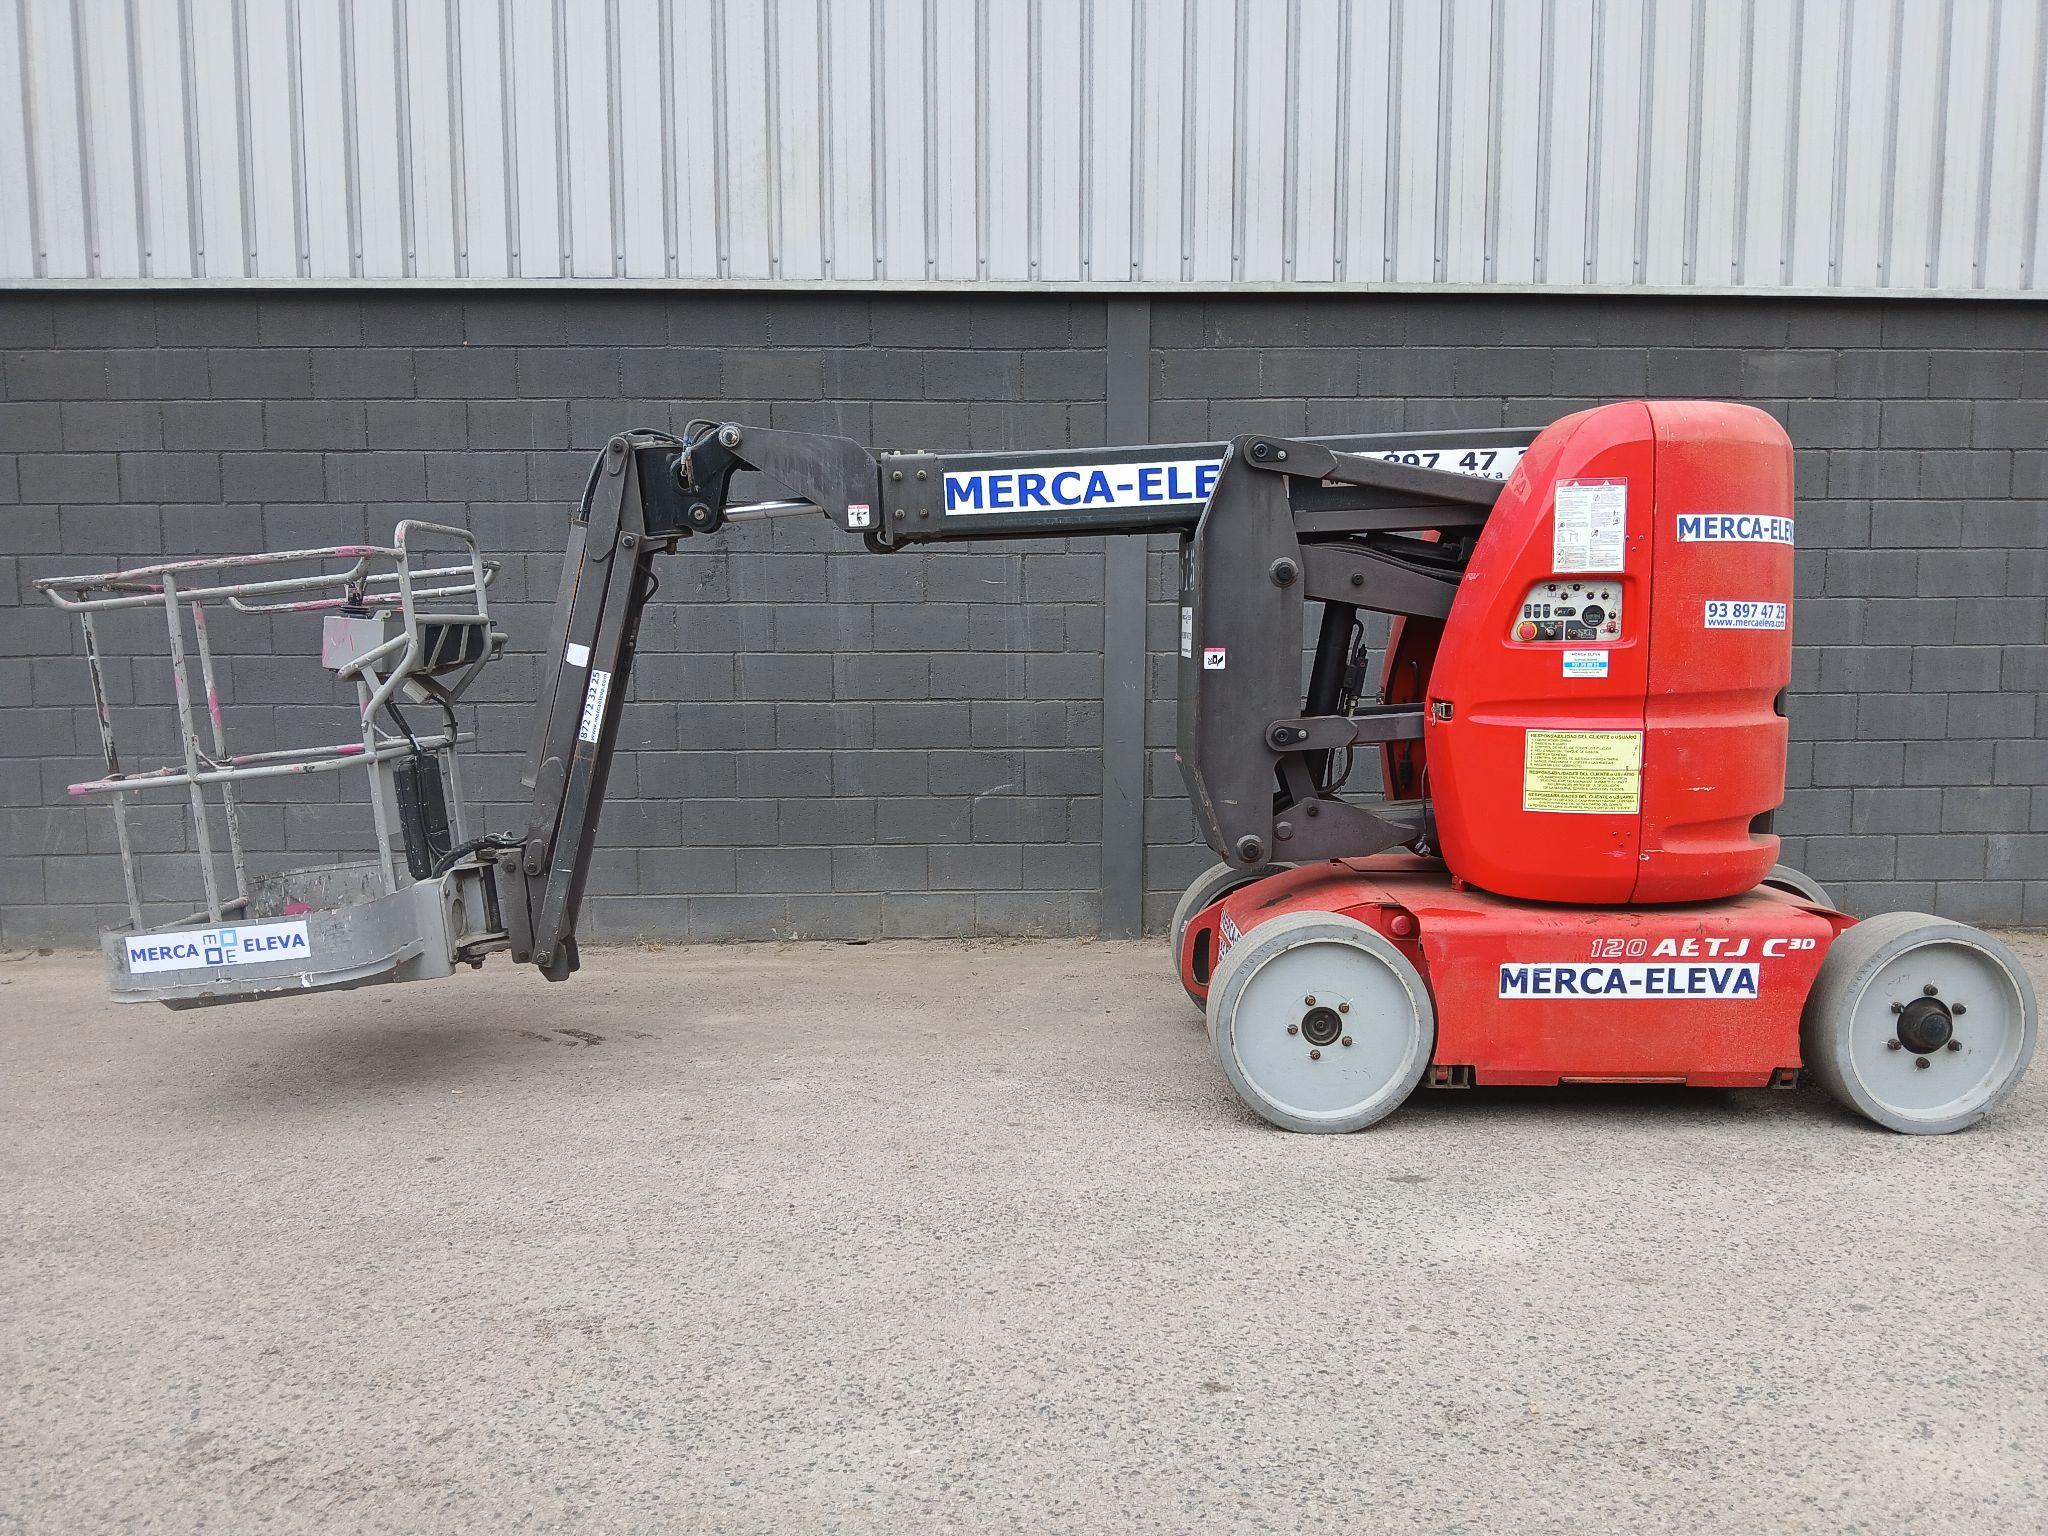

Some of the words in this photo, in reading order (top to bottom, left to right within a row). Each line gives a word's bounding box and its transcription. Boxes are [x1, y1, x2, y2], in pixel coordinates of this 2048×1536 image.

[1459, 451, 1498, 471] 47
[1708, 603, 1728, 618] 93
[1733, 603, 1758, 618] 897
[1761, 604, 1774, 619] 47
[1776, 605, 1785, 620] 25
[1708, 618, 1785, 628] www.mercaeleva.com
[591, 672, 600, 685] 25
[588, 687, 597, 702] 32
[585, 703, 594, 717] 72
[580, 719, 591, 739] 872
[131, 943, 199, 963] MERCA
[243, 933, 306, 953] ELEVA
[1590, 938, 1648, 958] 120
[1500, 967, 1756, 994] MERCA-ELEVA
